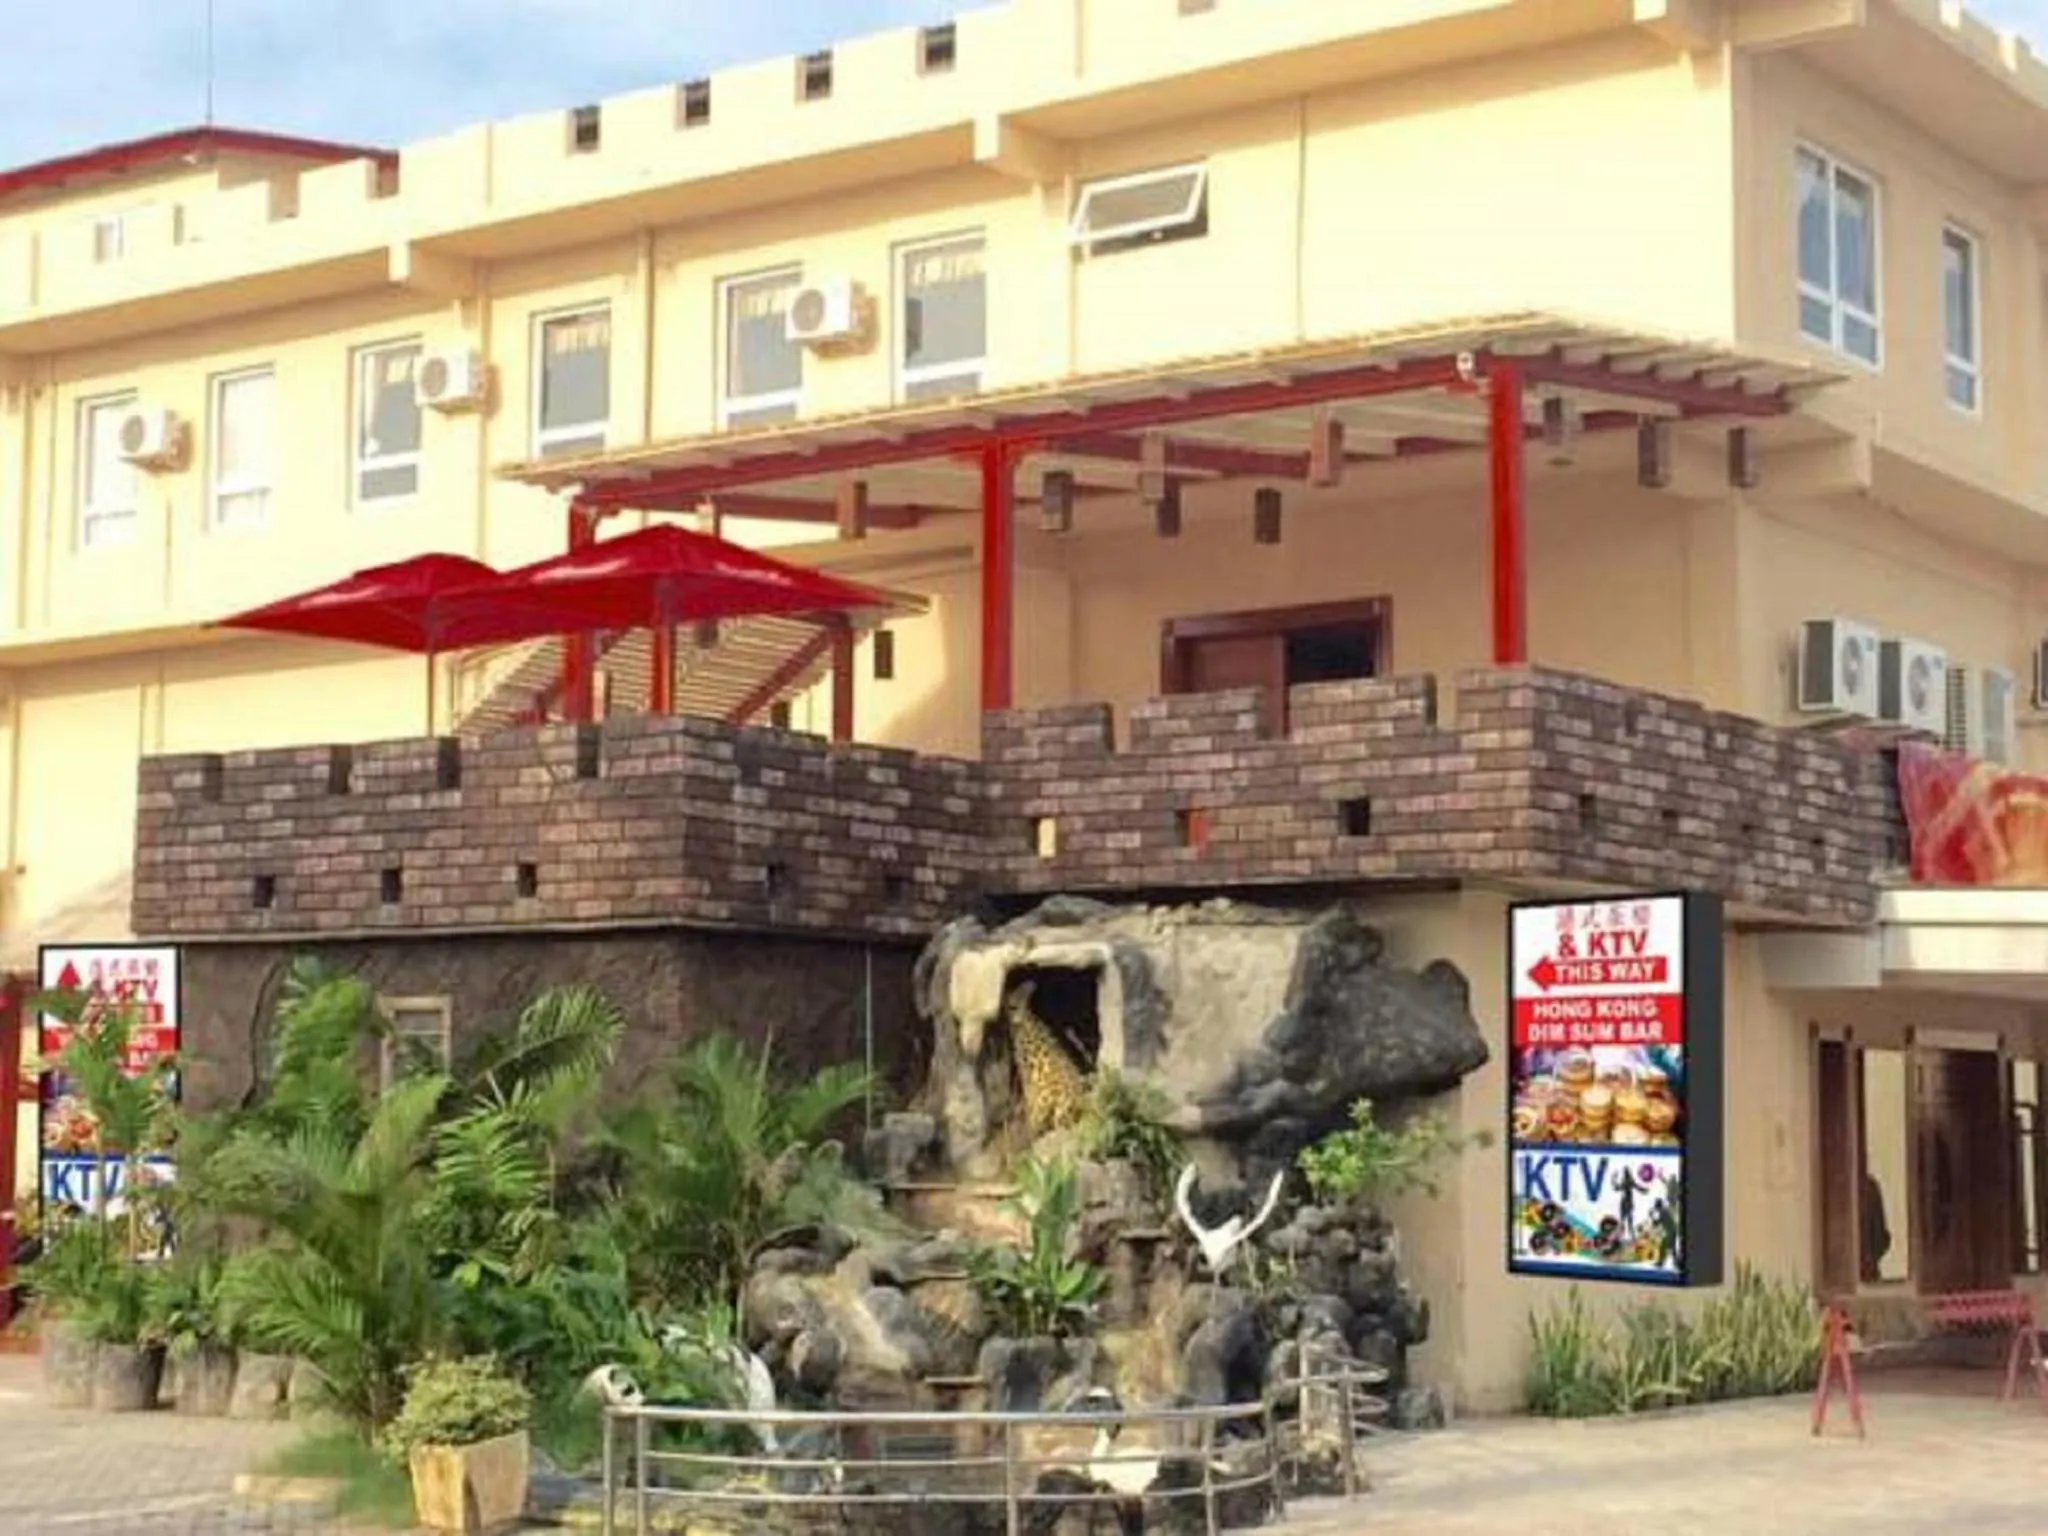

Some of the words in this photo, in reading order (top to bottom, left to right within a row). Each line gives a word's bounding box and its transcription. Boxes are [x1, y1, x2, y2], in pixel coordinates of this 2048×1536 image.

[1558, 934, 1577, 957] &
[1588, 930, 1648, 957] KTV
[1556, 963, 1604, 982] THIS
[1608, 961, 1655, 980] WAY
[1533, 1000, 1592, 1018] HONG
[1597, 998, 1657, 1017] KONG
[1528, 1023, 1564, 1042] DIM
[1570, 1021, 1614, 1042] SUM
[1619, 1020, 1663, 1040] BAR
[49, 1163, 120, 1201] KTV
[1524, 1155, 1608, 1202] KTV
